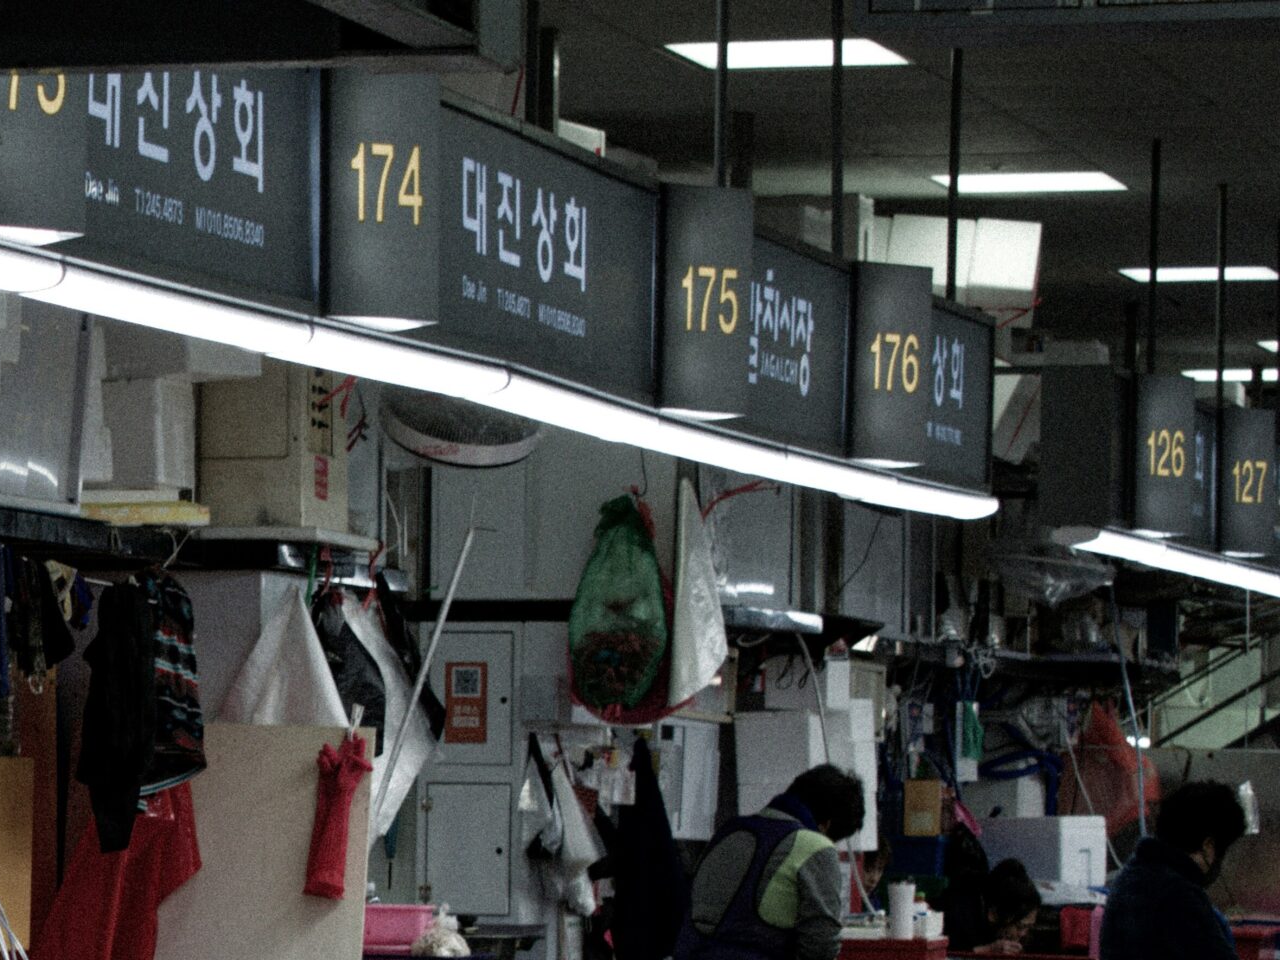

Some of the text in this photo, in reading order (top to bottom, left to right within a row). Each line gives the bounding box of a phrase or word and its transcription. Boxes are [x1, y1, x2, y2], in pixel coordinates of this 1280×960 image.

[350, 142, 424, 227] 174
[461, 156, 588, 293] 대진상회
[681, 265, 740, 335] 175
[870, 332, 920, 395] 176
[932, 334, 966, 410] 상회
[1146, 428, 1186, 478] 126
[1232, 459, 1268, 505] 127
